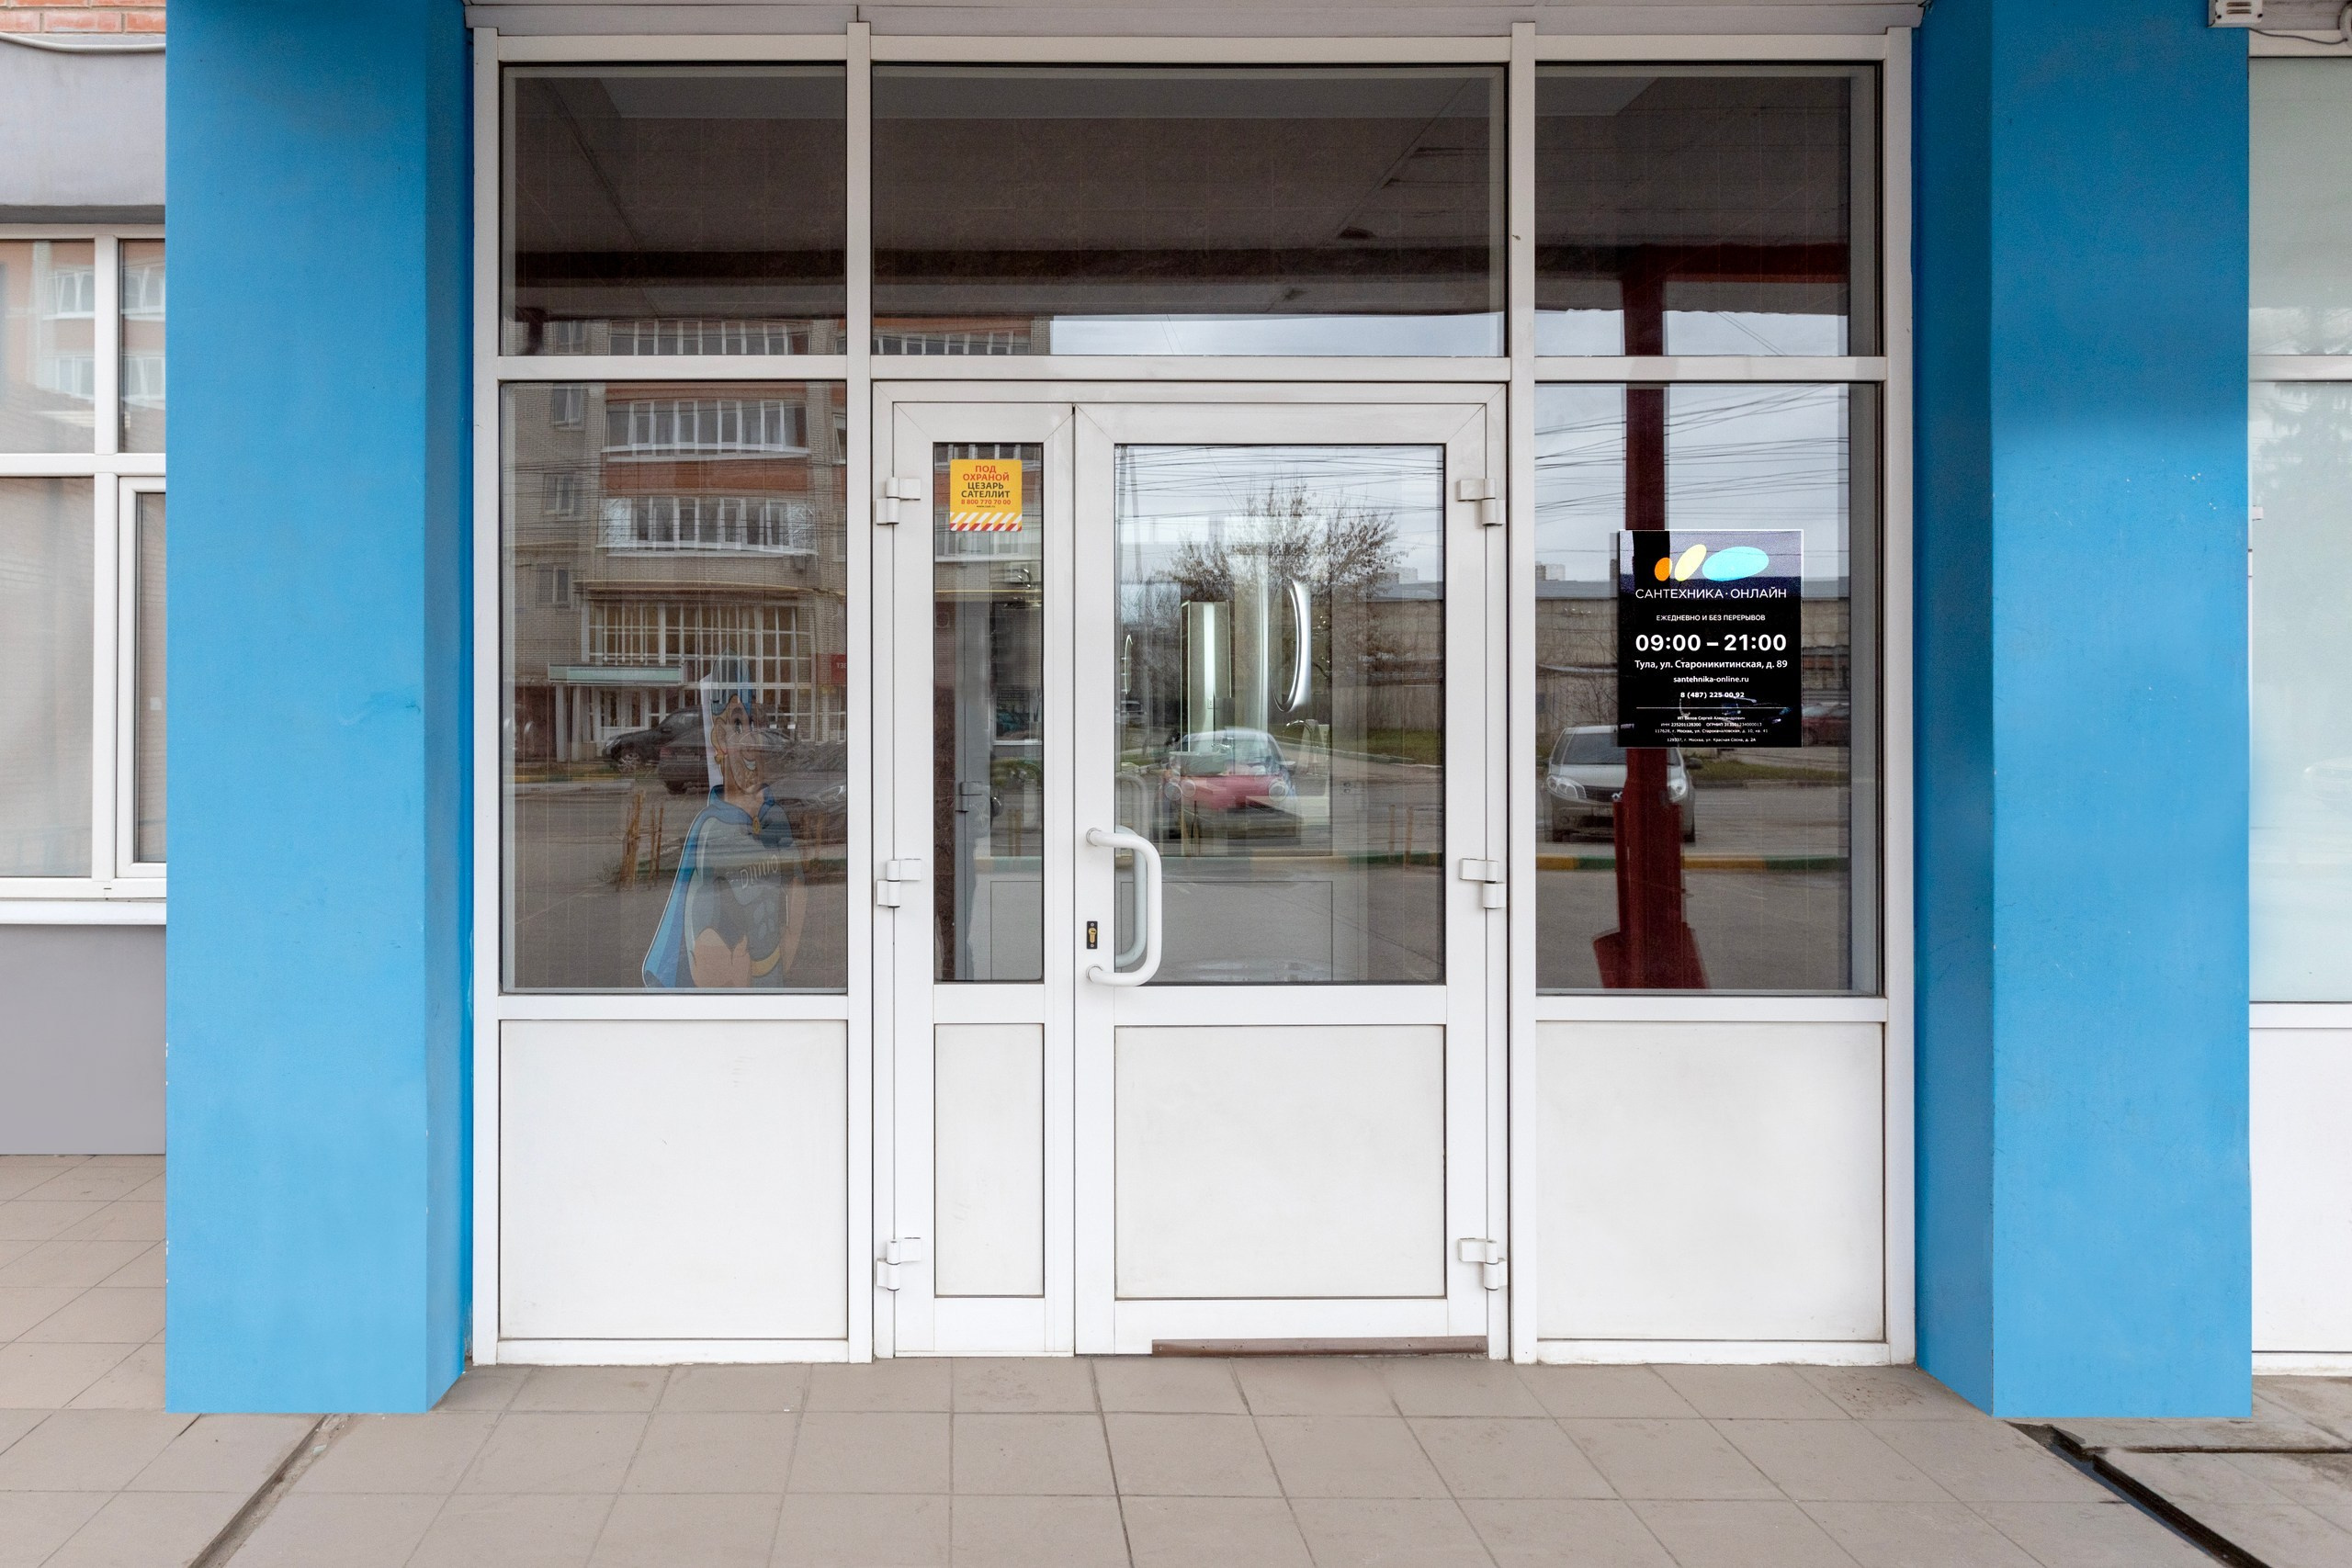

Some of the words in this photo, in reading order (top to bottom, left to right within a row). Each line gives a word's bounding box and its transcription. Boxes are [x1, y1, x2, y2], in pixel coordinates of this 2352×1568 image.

[963, 472, 1009, 480] ОХРАНОЙ
[967, 482, 1004, 491] ЦЕЗАРЬ
[1635, 589, 1724, 599] САНТЕХНИКА
[1730, 586, 1787, 599] ОНЛАЙН
[1635, 634, 1701, 651] 09:00
[1724, 634, 1787, 651] 21:00
[1634, 660, 1657, 670] Тула,
[1660, 661, 1673, 670] ул.
[1675, 660, 1765, 670] Староникитинская,
